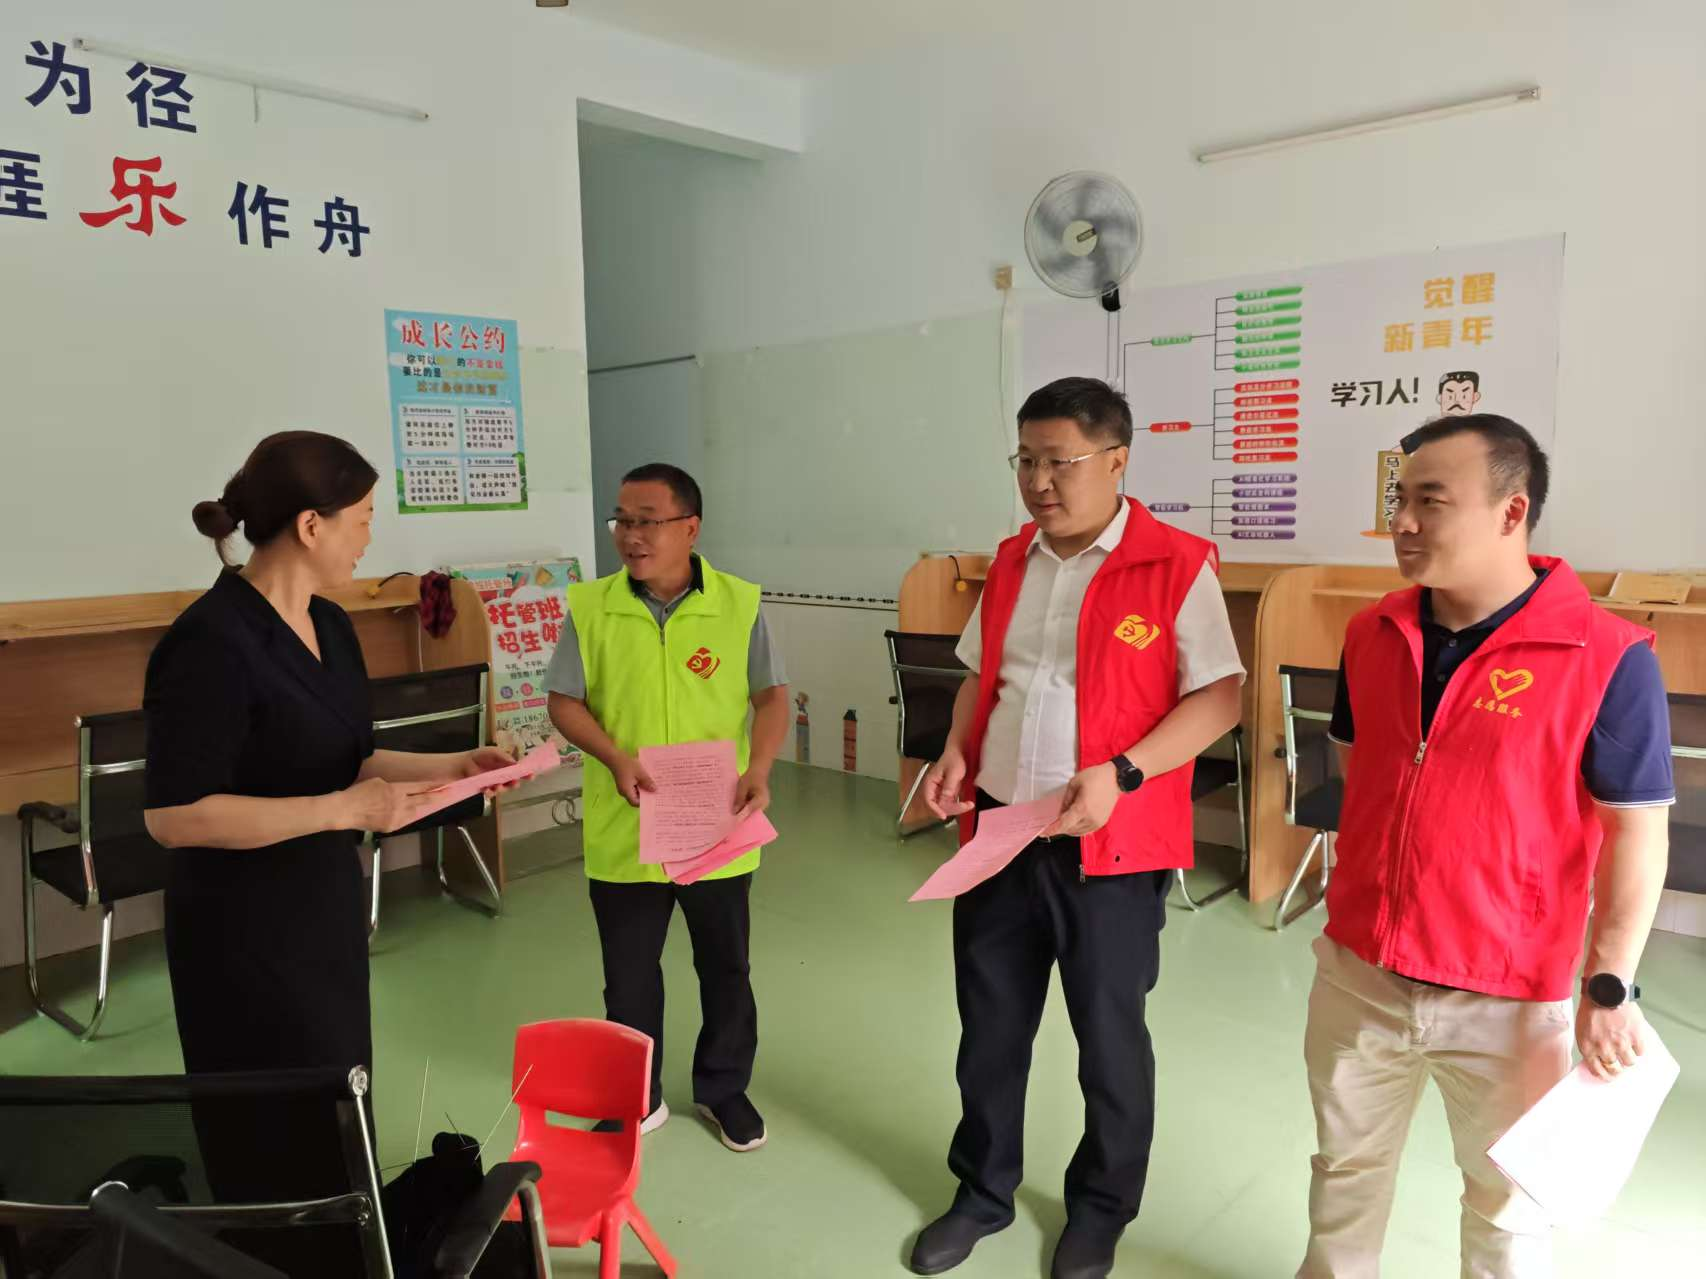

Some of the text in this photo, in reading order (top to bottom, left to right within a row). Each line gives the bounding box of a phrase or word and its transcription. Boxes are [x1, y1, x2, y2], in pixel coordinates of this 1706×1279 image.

[25, 40, 197, 133] 为径
[1424, 271, 1496, 309] 觉醒
[402, 320, 505, 353] 成长公约
[1383, 315, 1494, 353] 新青年
[1331, 377, 1419, 408] 学习人!
[488, 596, 564, 629] 托管班
